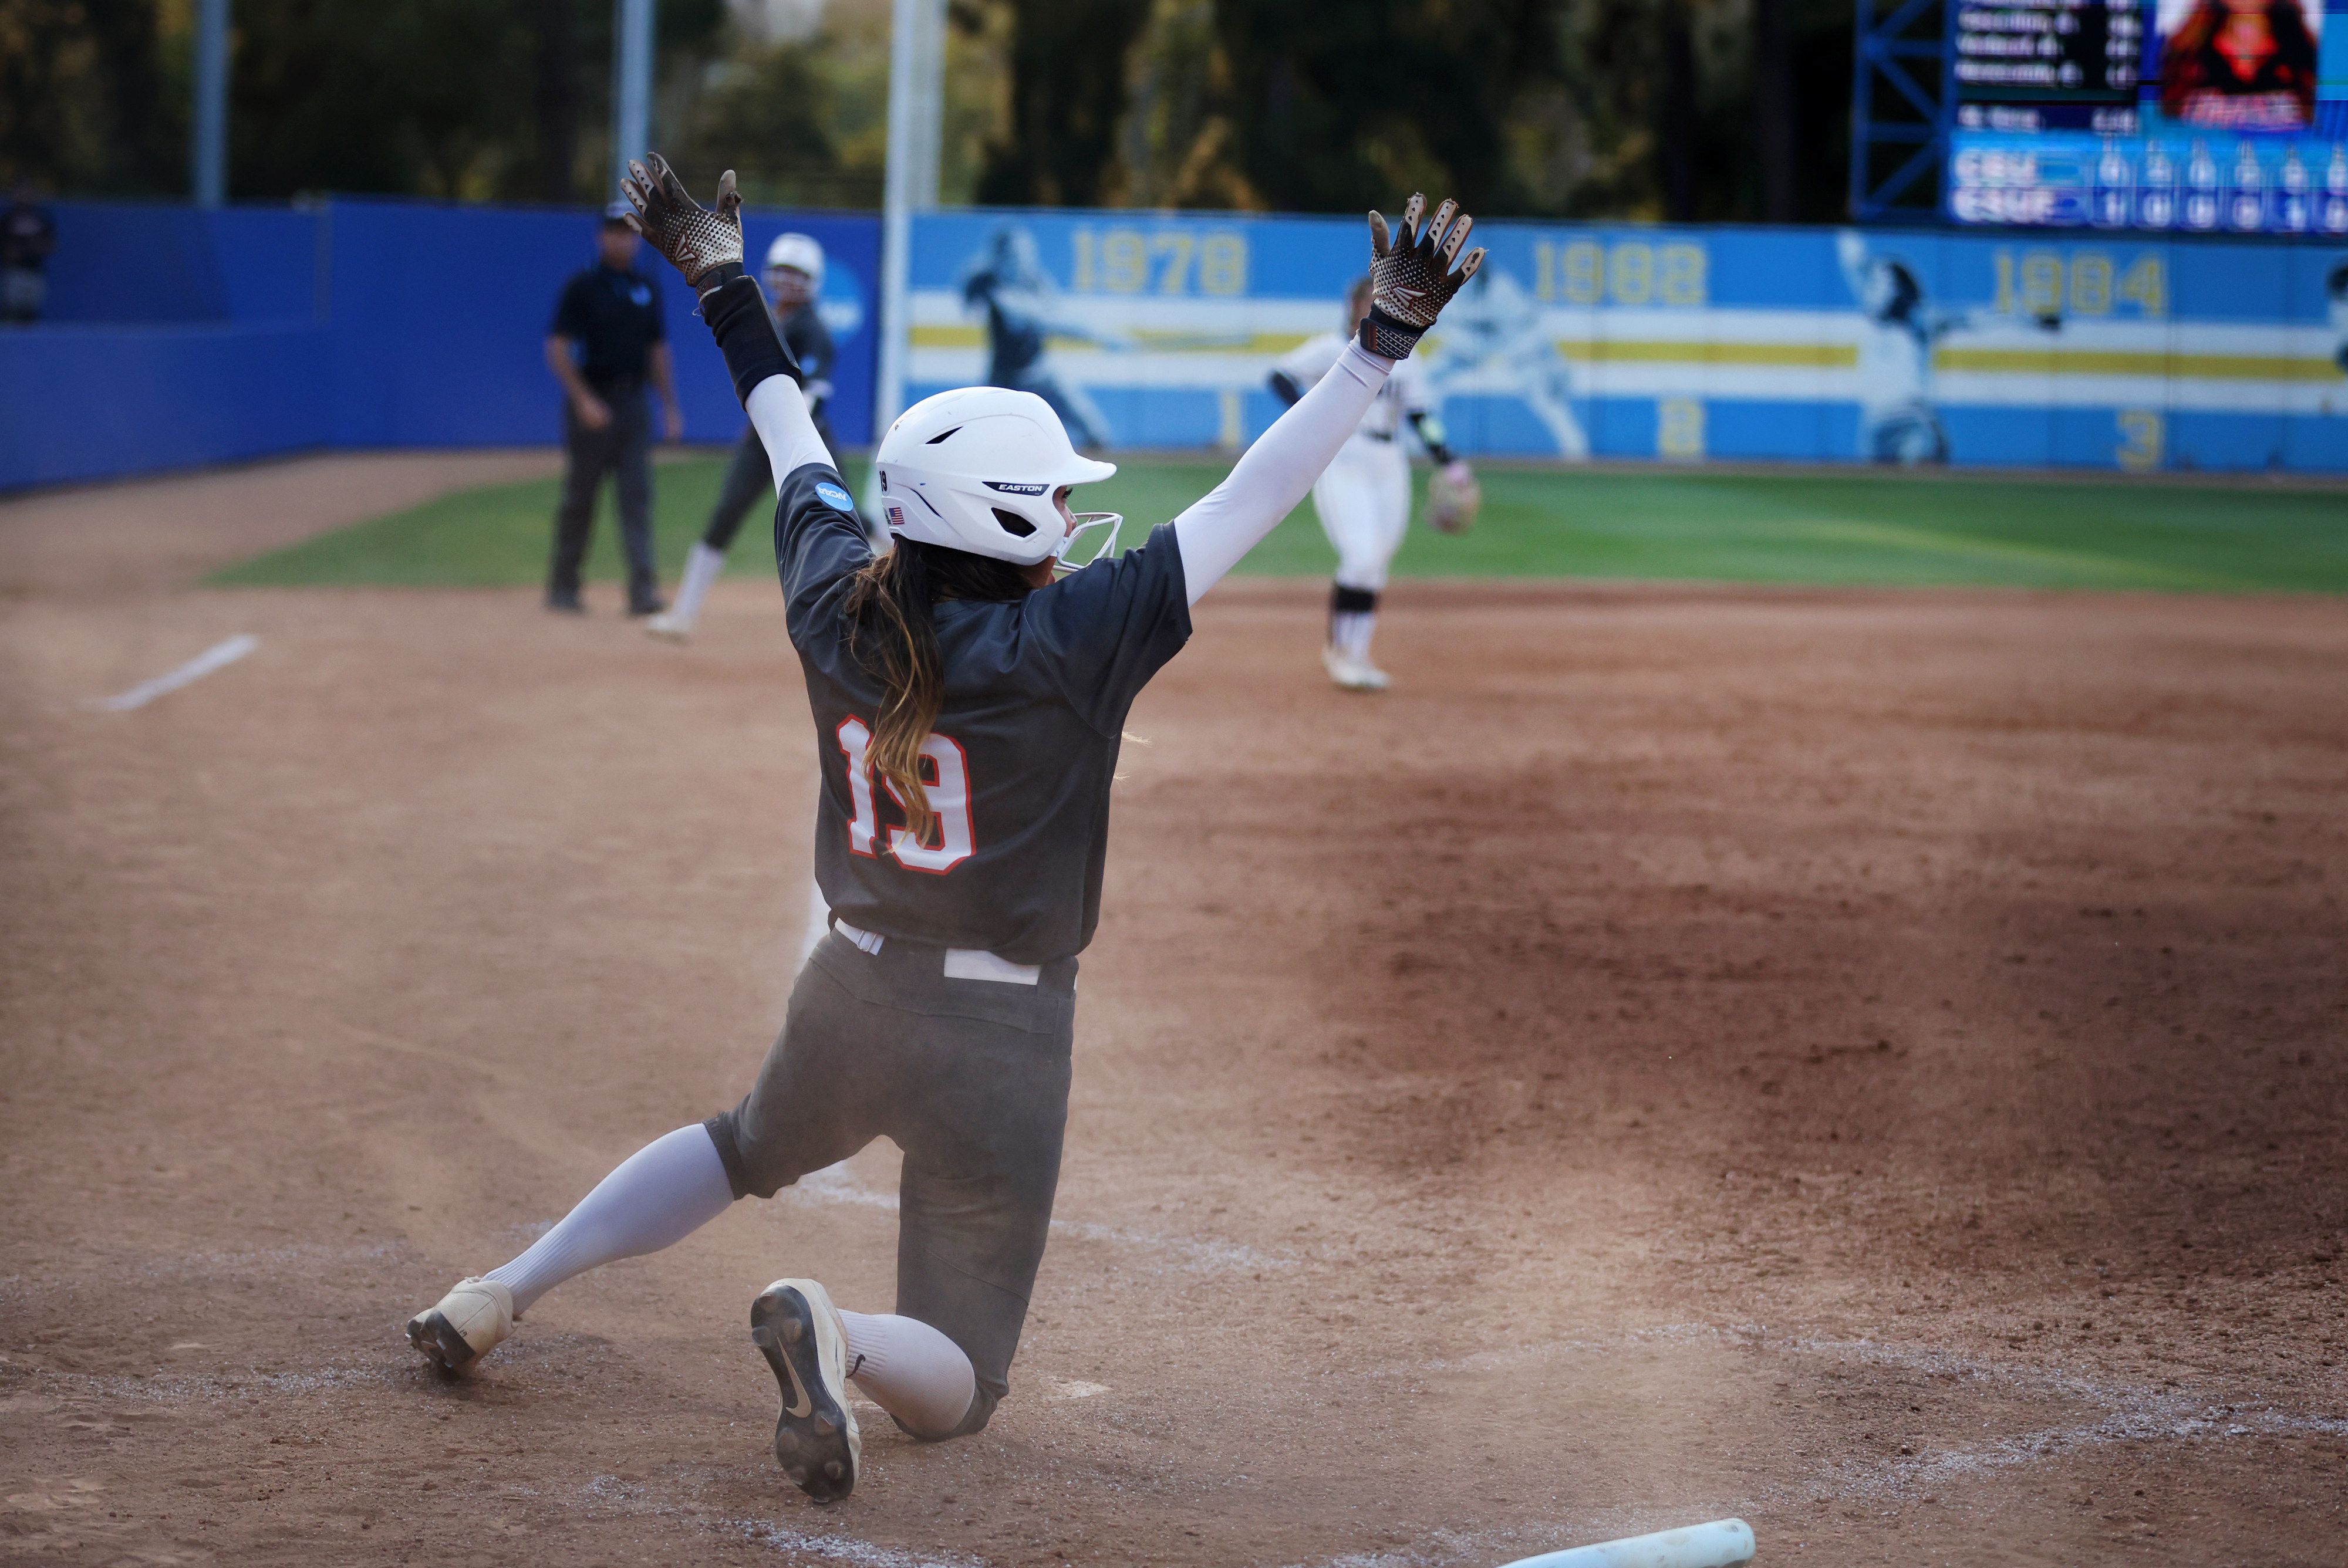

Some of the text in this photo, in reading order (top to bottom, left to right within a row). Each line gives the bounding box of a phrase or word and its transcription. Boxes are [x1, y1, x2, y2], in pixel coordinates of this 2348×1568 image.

[1072, 229, 1247, 294] 1978
[1534, 240, 1707, 304] 1982
[1993, 249, 2165, 317] 1984
[2116, 410, 2163, 471] 3
[817, 486, 848, 502] NCAA
[879, 471, 888, 492] 19
[835, 712, 977, 877] 19
